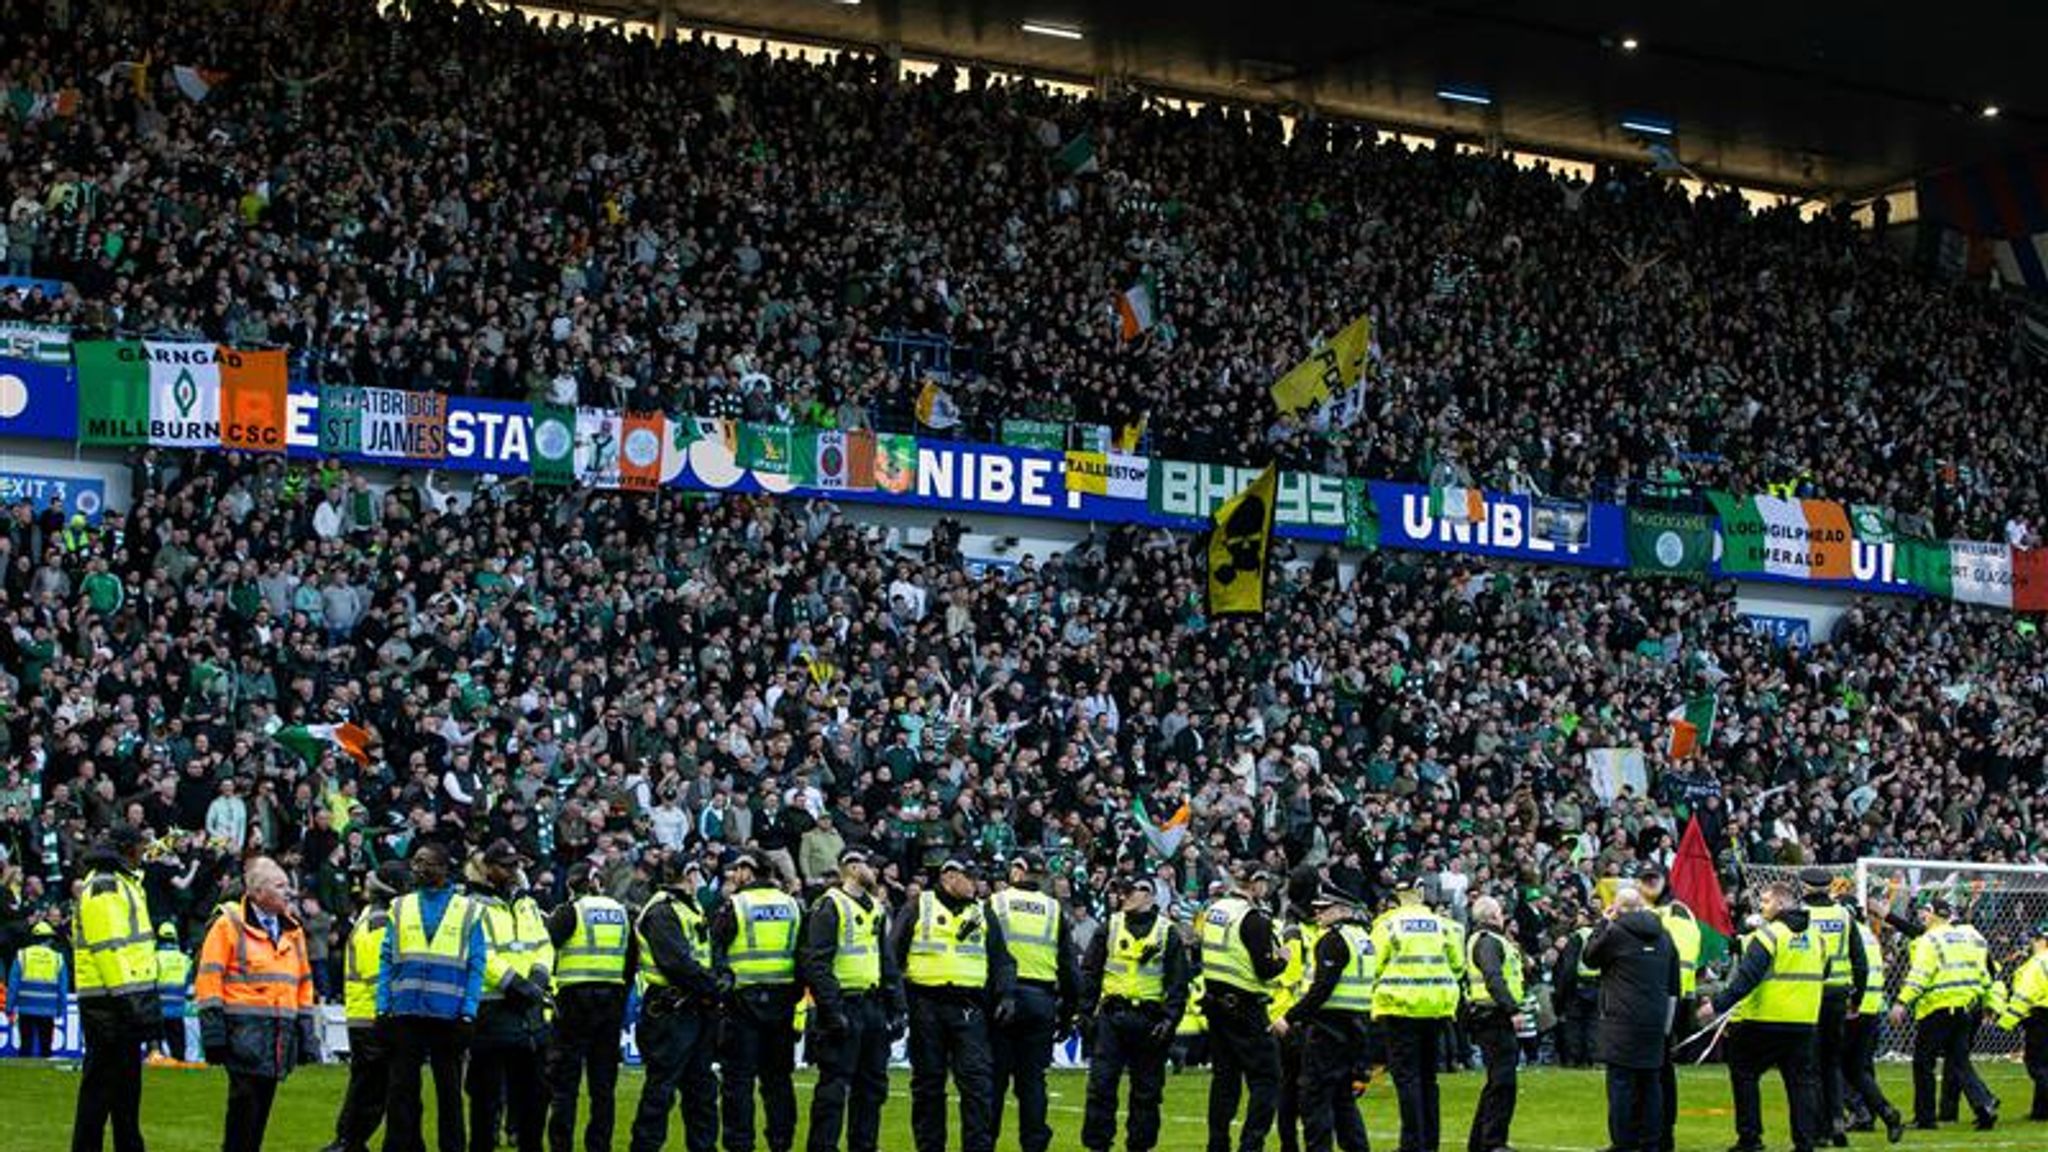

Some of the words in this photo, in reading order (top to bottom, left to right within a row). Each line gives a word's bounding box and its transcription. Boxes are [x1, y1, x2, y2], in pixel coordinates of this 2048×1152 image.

[118, 347, 243, 368] GARNGAD
[88, 419, 221, 440] MILLBURN
[228, 424, 279, 443] CSC
[366, 420, 441, 455] JAMES
[447, 410, 534, 462] STA
[917, 448, 1083, 510] NIBE
[1727, 522, 1845, 543] LOCHGILPHEAD
[1748, 547, 1825, 567] EMERALD
